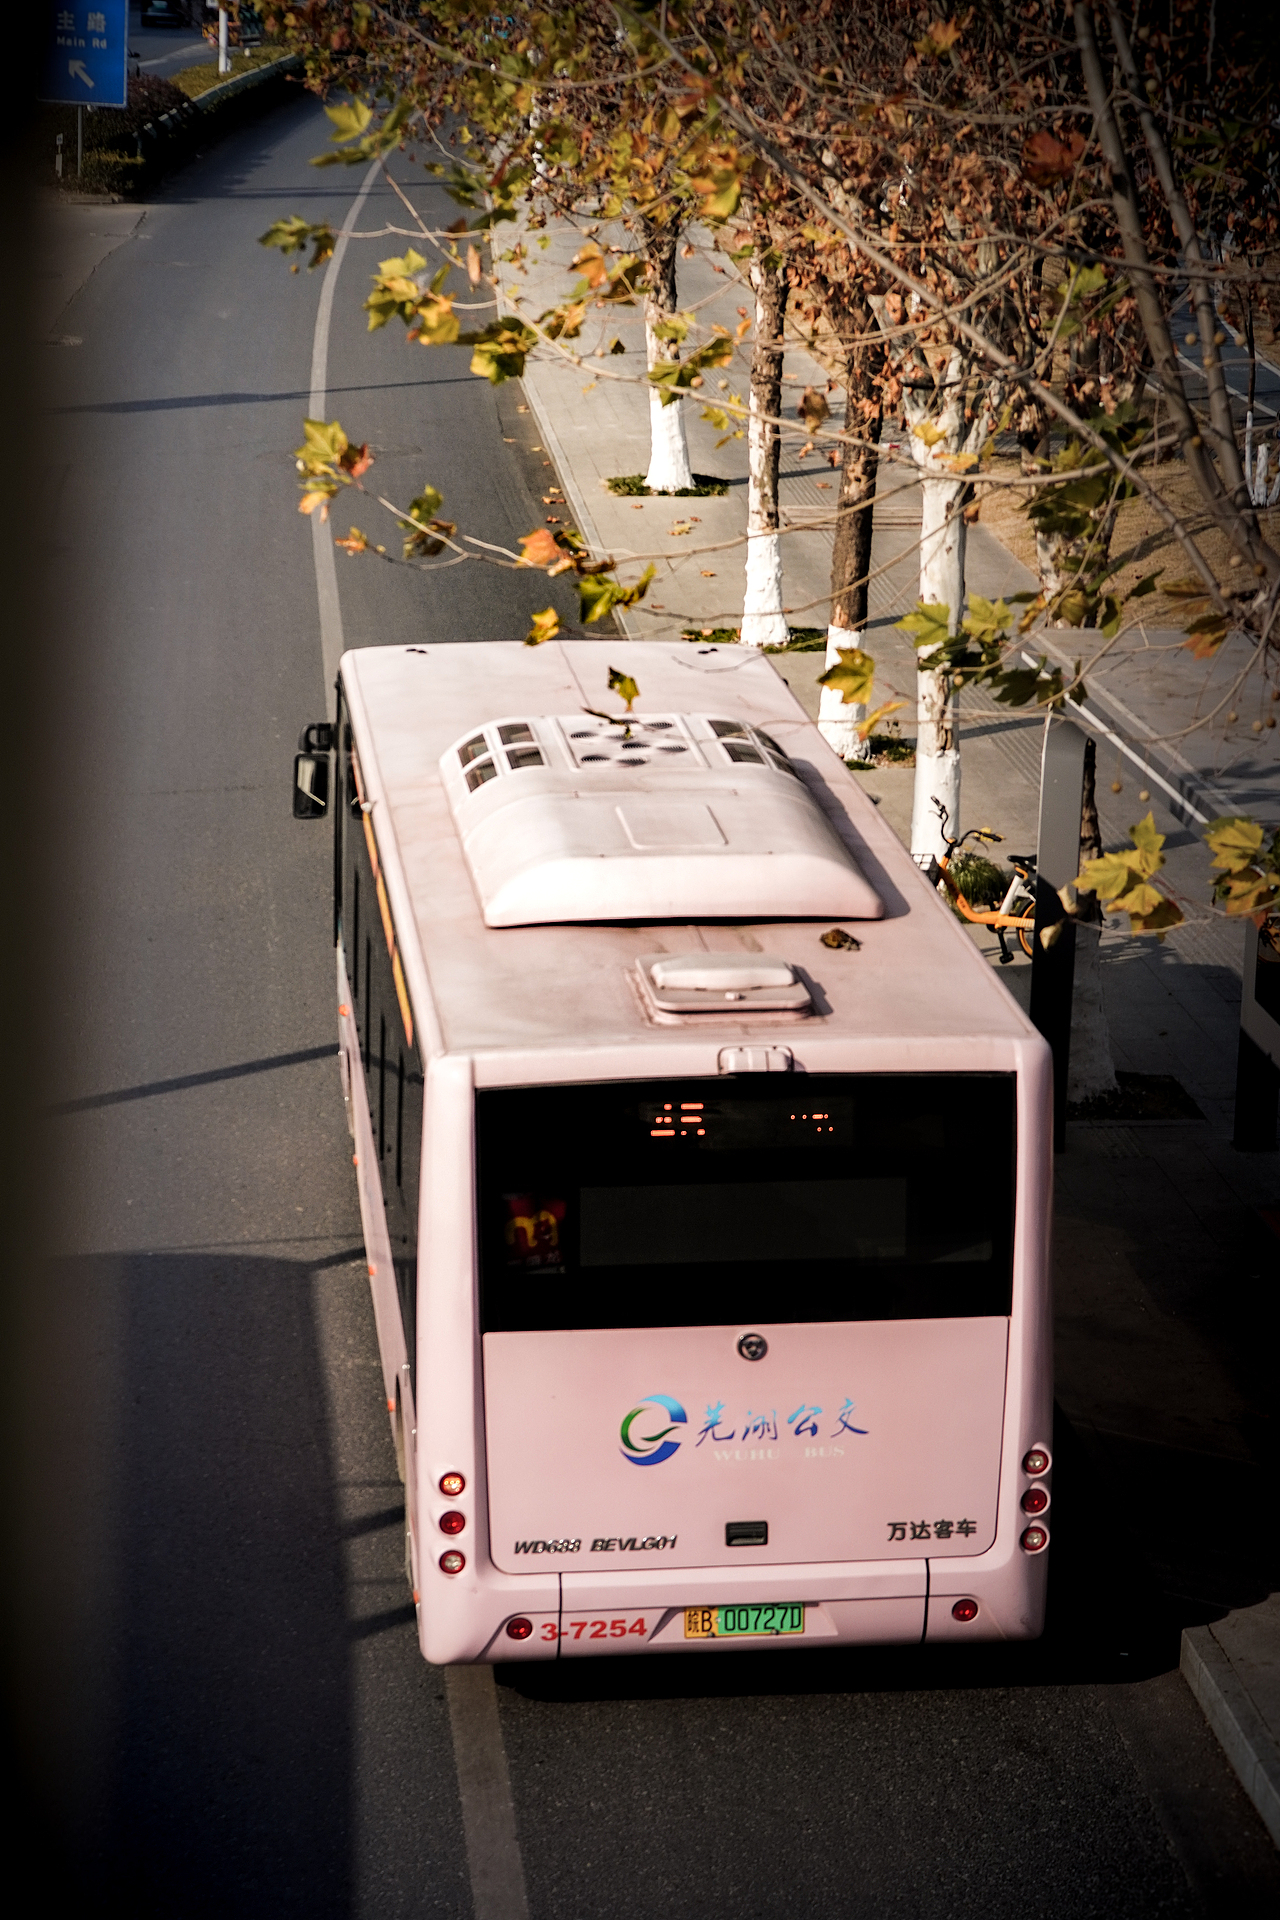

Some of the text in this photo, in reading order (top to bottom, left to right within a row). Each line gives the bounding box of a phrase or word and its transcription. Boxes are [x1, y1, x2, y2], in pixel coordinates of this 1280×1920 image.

[56, 36, 108, 50] Main Rd
[694, 1398, 870, 1447] 芜湖公交
[712, 1446, 846, 1462] WUHU BUS
[886, 1518, 978, 1542] 万达客车
[540, 1617, 648, 1642] 3-7254
